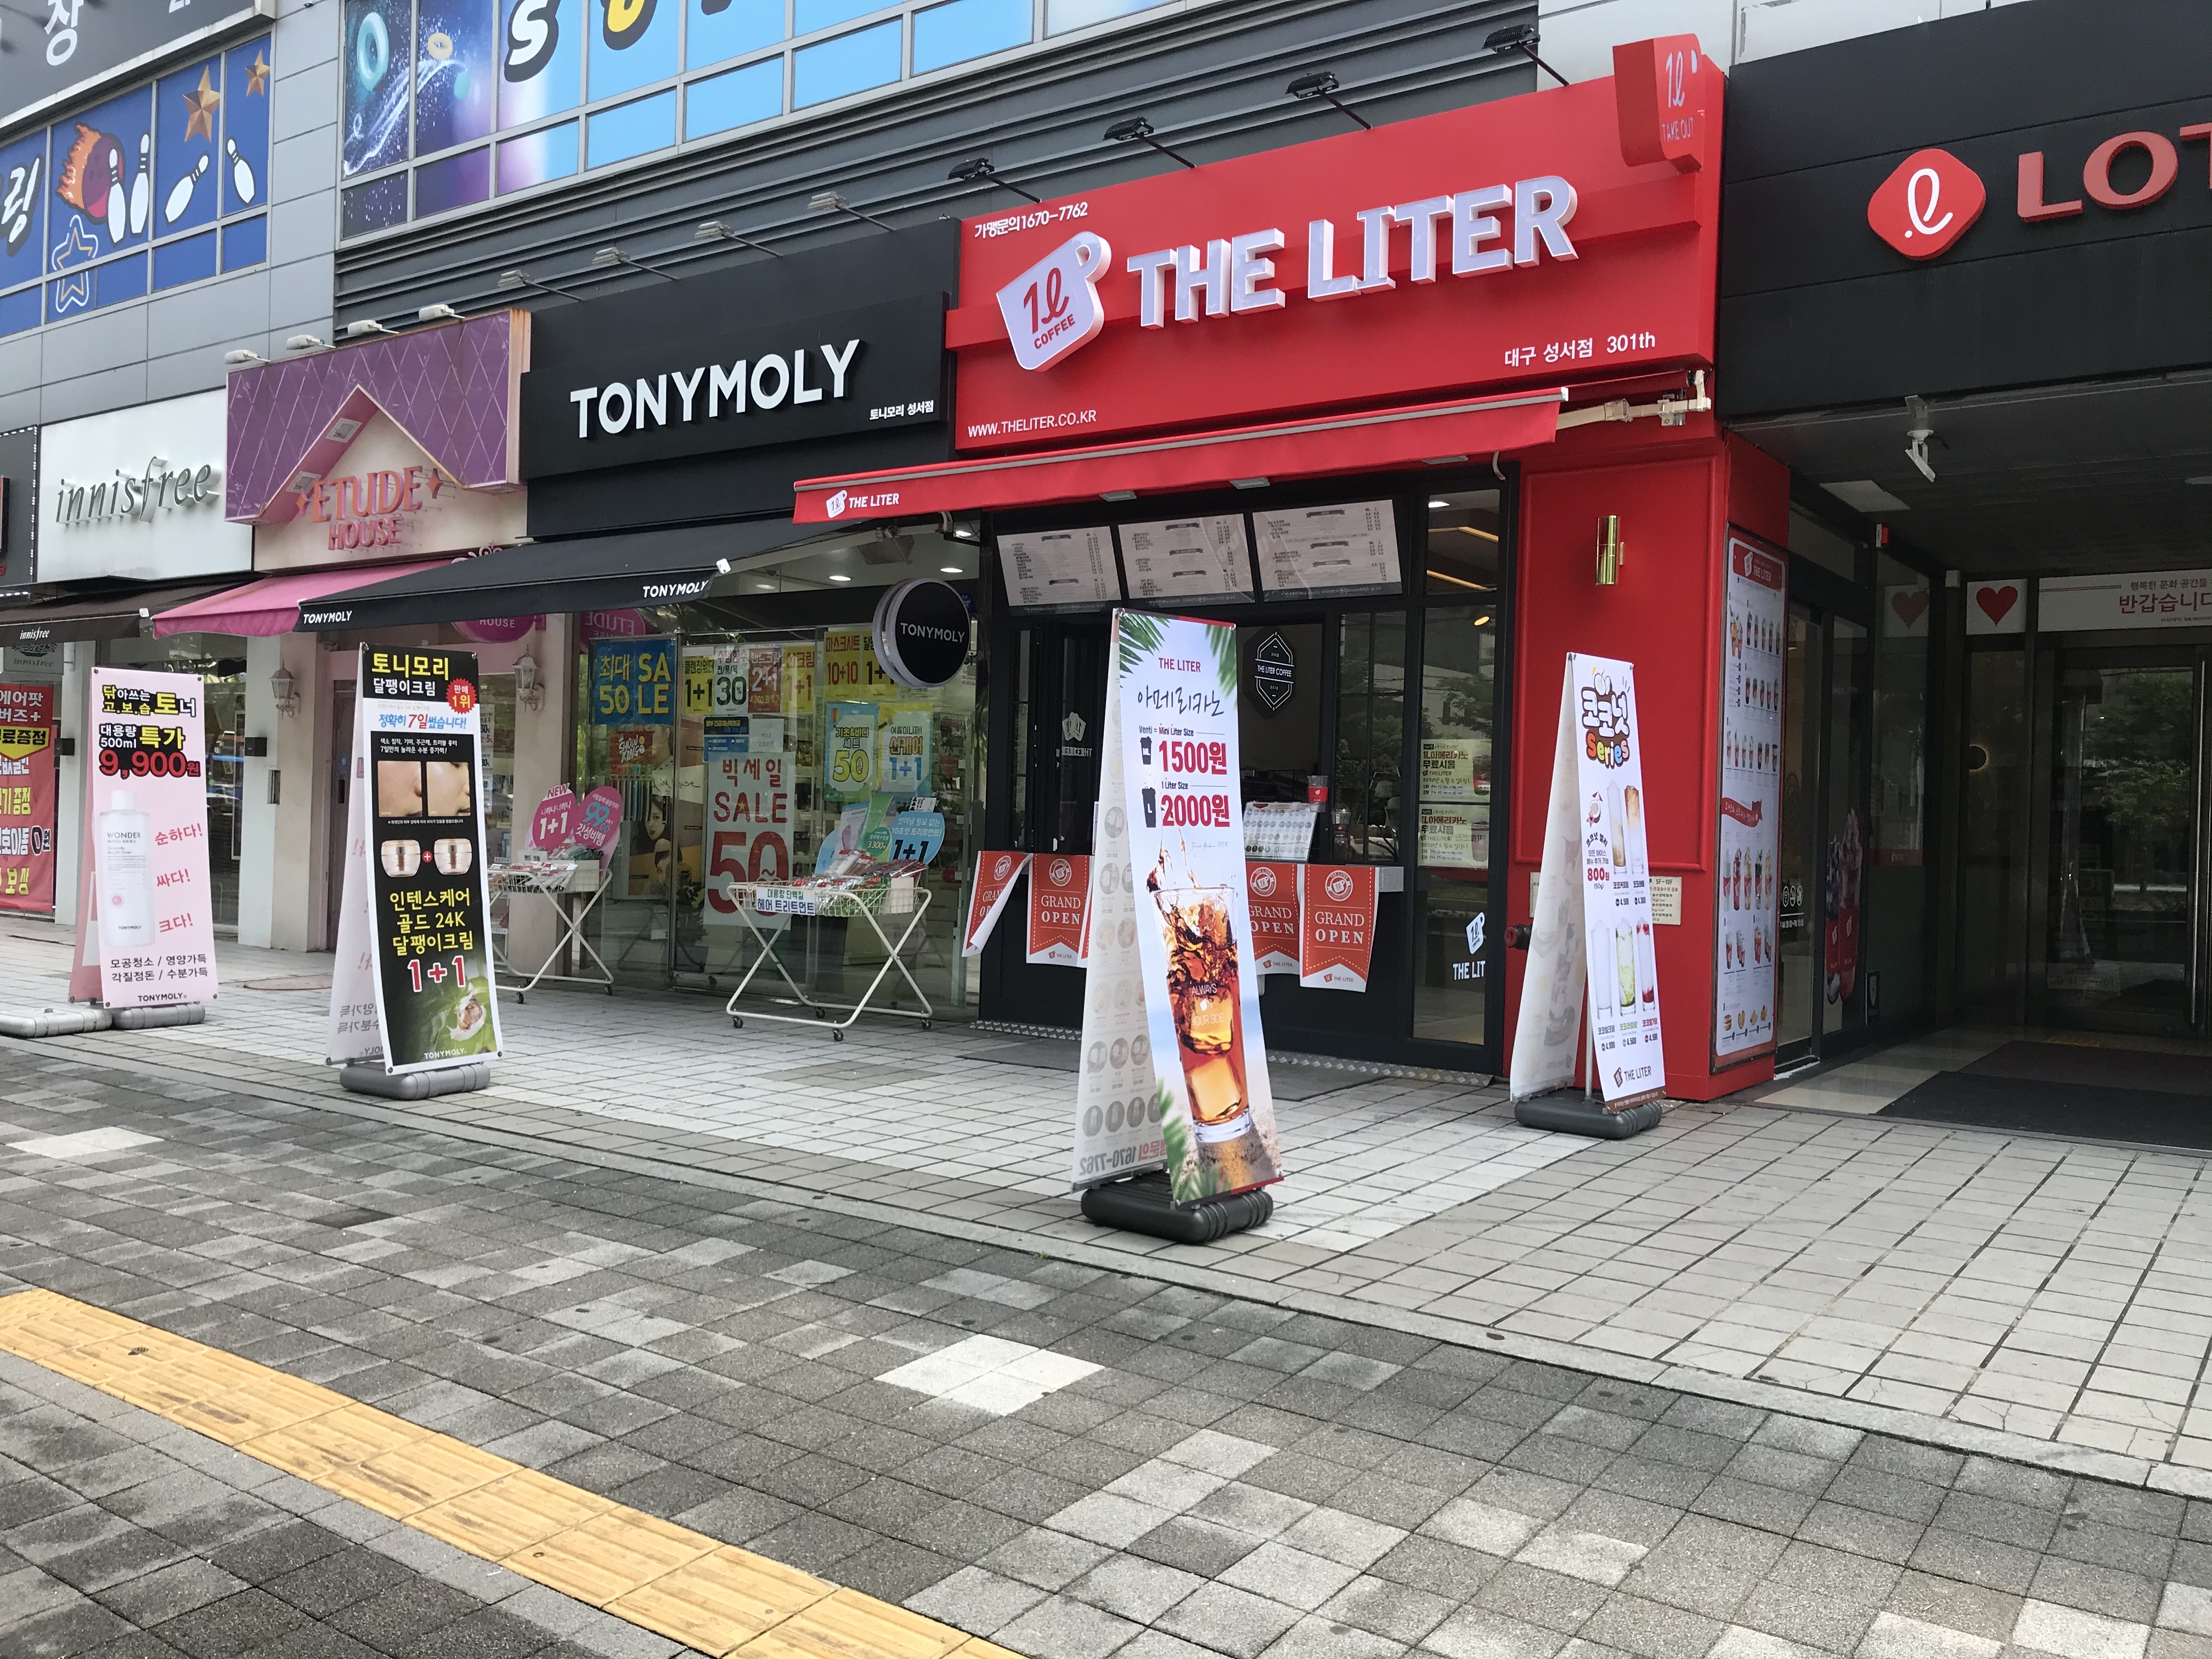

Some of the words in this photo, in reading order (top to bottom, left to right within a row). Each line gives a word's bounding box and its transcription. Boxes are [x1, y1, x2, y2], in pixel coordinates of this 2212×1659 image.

[1662, 120, 1680, 143] TAKE
[1680, 116, 1694, 138] OUT
[1127, 228, 1285, 329] THE
[1308, 176, 1579, 302] LITER
[1034, 313, 1075, 349] COFFEE
[1504, 346, 1537, 368] 대구
[1543, 338, 1593, 363] 성서점
[1606, 331, 1656, 354] 301th
[570, 338, 860, 439] TONYMOLY
[869, 403, 905, 421] 토니모리
[906, 399, 934, 416] 성서점
[968, 409, 1097, 438] WWW.THELITER.CO.KR
[56, 455, 212, 519] innisfree
[313, 465, 425, 524] ETUDE
[849, 495, 867, 509] THE
[870, 493, 900, 507] LITER
[328, 517, 404, 551] HOUSE
[1760, 568, 1771, 583] LITER
[2159, 580, 2178, 589] 문화
[2180, 578, 2207, 589] 공간을
[642, 580, 709, 598] TONYMOLY
[303, 610, 353, 625] TONYMOLY
[479, 618, 515, 629] HOUSE
[20, 627, 50, 641] innisfree
[900, 622, 966, 643] TONYMOLY
[825, 635, 860, 652] 마스크시트
[371, 652, 449, 681] 토니모리
[599, 653, 630, 682] 최대
[638, 652, 672, 683] SA
[827, 661, 858, 685] 10+10
[1159, 657, 1175, 671] THE
[1177, 659, 1201, 673] LITER
[1257, 664, 1265, 673] THE
[1265, 666, 1276, 675] LITER
[1276, 668, 1292, 678] COFFEE
[373, 678, 436, 697] 달팽이크림
[752, 666, 777, 692] 2+1
[787, 674, 812, 701] 1+1
[102, 685, 151, 702] 닦아쓰는
[453, 684, 469, 695] 판매
[684, 678, 713, 707] 1+1
[154, 691, 196, 717] 토너
[452, 694, 471, 709] 1위
[638, 685, 670, 715] LE
[1137, 685, 1224, 717] 아메리카노
[378, 714, 407, 728] 정확히
[1581, 688, 1630, 738] 코코넛
[0, 729, 46, 746] 료증정
[100, 723, 137, 737] 대용량
[100, 737, 137, 748] 500ml
[139, 725, 185, 750] 특가
[1139, 725, 1153, 735] Venti
[1159, 724, 1170, 736] Mini
[1170, 724, 1182, 736] Liter
[1183, 728, 1194, 737] Size
[843, 738, 860, 749] 세트
[1142, 747, 1150, 757] ML
[1587, 732, 1629, 768] Series
[99, 749, 201, 778] 9,900원
[1159, 740, 1227, 776] 1500원
[1423, 751, 1469, 760] 1L아메리카노
[1423, 760, 1455, 769] 무료시음
[722, 758, 782, 788] 빅세일
[889, 757, 922, 781] 1+1
[548, 782, 570, 798] NEW
[1165, 778, 1177, 789] Liter
[1178, 781, 1188, 790] Size
[713, 792, 789, 824] SALE
[1160, 794, 1231, 828] 2000원
[539, 811, 569, 840] 1+1
[575, 822, 607, 847] 갓성비템
[1421, 825, 1454, 834] 무료시음
[155, 823, 203, 847] 순하다!
[1586, 832, 1599, 848] 코코넛
[892, 839, 930, 863] 1+1
[156, 868, 190, 888] 싸다!
[1587, 867, 1610, 881] 800원
[390, 887, 470, 912] 인텐스케어
[768, 889, 785, 899] 대용량
[786, 890, 804, 900] 단백질
[1041, 895, 1081, 910] GRAND
[757, 898, 773, 912] 헤어
[775, 899, 815, 915] 트리트먼트
[1249, 905, 1292, 919] GRAND
[159, 913, 193, 933] 크다!
[397, 914, 431, 934] 골드
[435, 911, 466, 929] 24K
[1041, 911, 1081, 925] OPEN
[1251, 920, 1295, 934] OPEN
[1314, 911, 1365, 927] GRAND
[392, 930, 473, 956] 달팽이크림
[1315, 928, 1364, 944] OPEN
[111, 957, 154, 969] 모공청소
[166, 953, 207, 966] 영양가득
[111, 970, 155, 984] 각질정돈
[167, 967, 208, 979] 수분가득
[408, 955, 466, 993] 1+1
[1453, 962, 1470, 980] THE
[137, 992, 184, 1002] TONYMOLY
[1191, 983, 1217, 996] ALWAYS
[1190, 1015, 1210, 1026] YOUR
[1210, 1012, 1224, 1024] SIDE
[424, 1047, 465, 1059] TONYMOLY
[1624, 1069, 1636, 1082] THE
[1637, 1065, 1652, 1079] LITER
